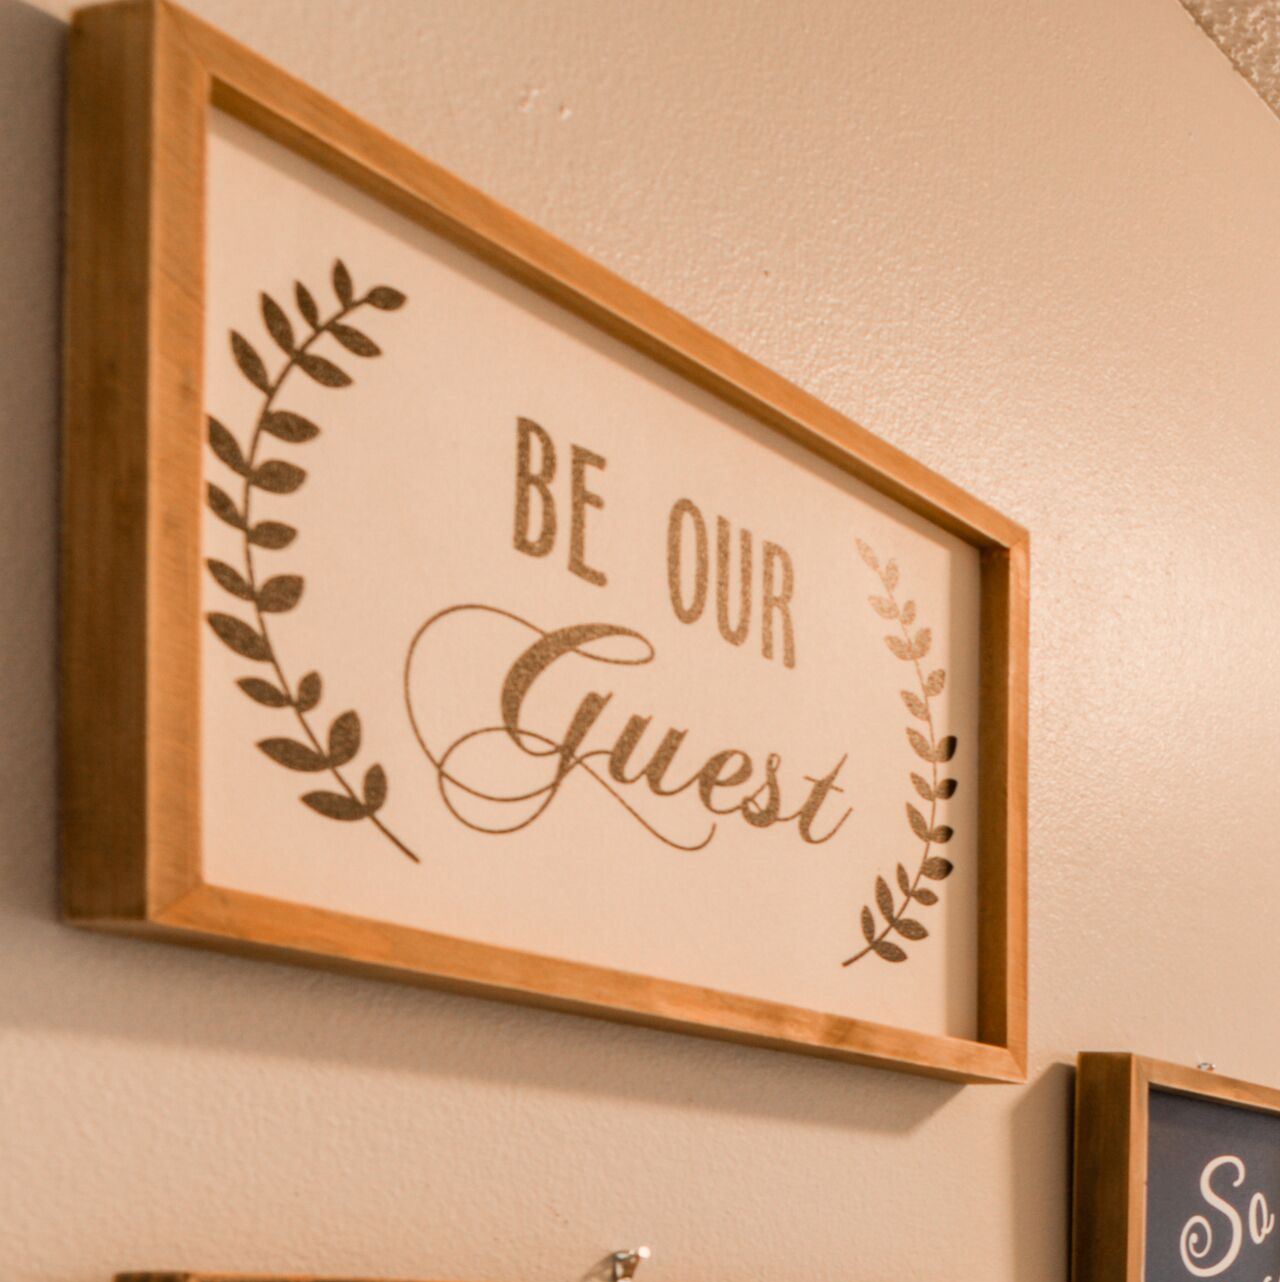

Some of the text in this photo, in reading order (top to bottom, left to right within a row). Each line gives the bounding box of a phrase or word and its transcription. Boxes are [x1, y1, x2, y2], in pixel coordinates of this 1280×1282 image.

[512, 416, 796, 670] BE OUR
[405, 604, 853, 851] Guest
[1180, 1155, 1275, 1277] So
